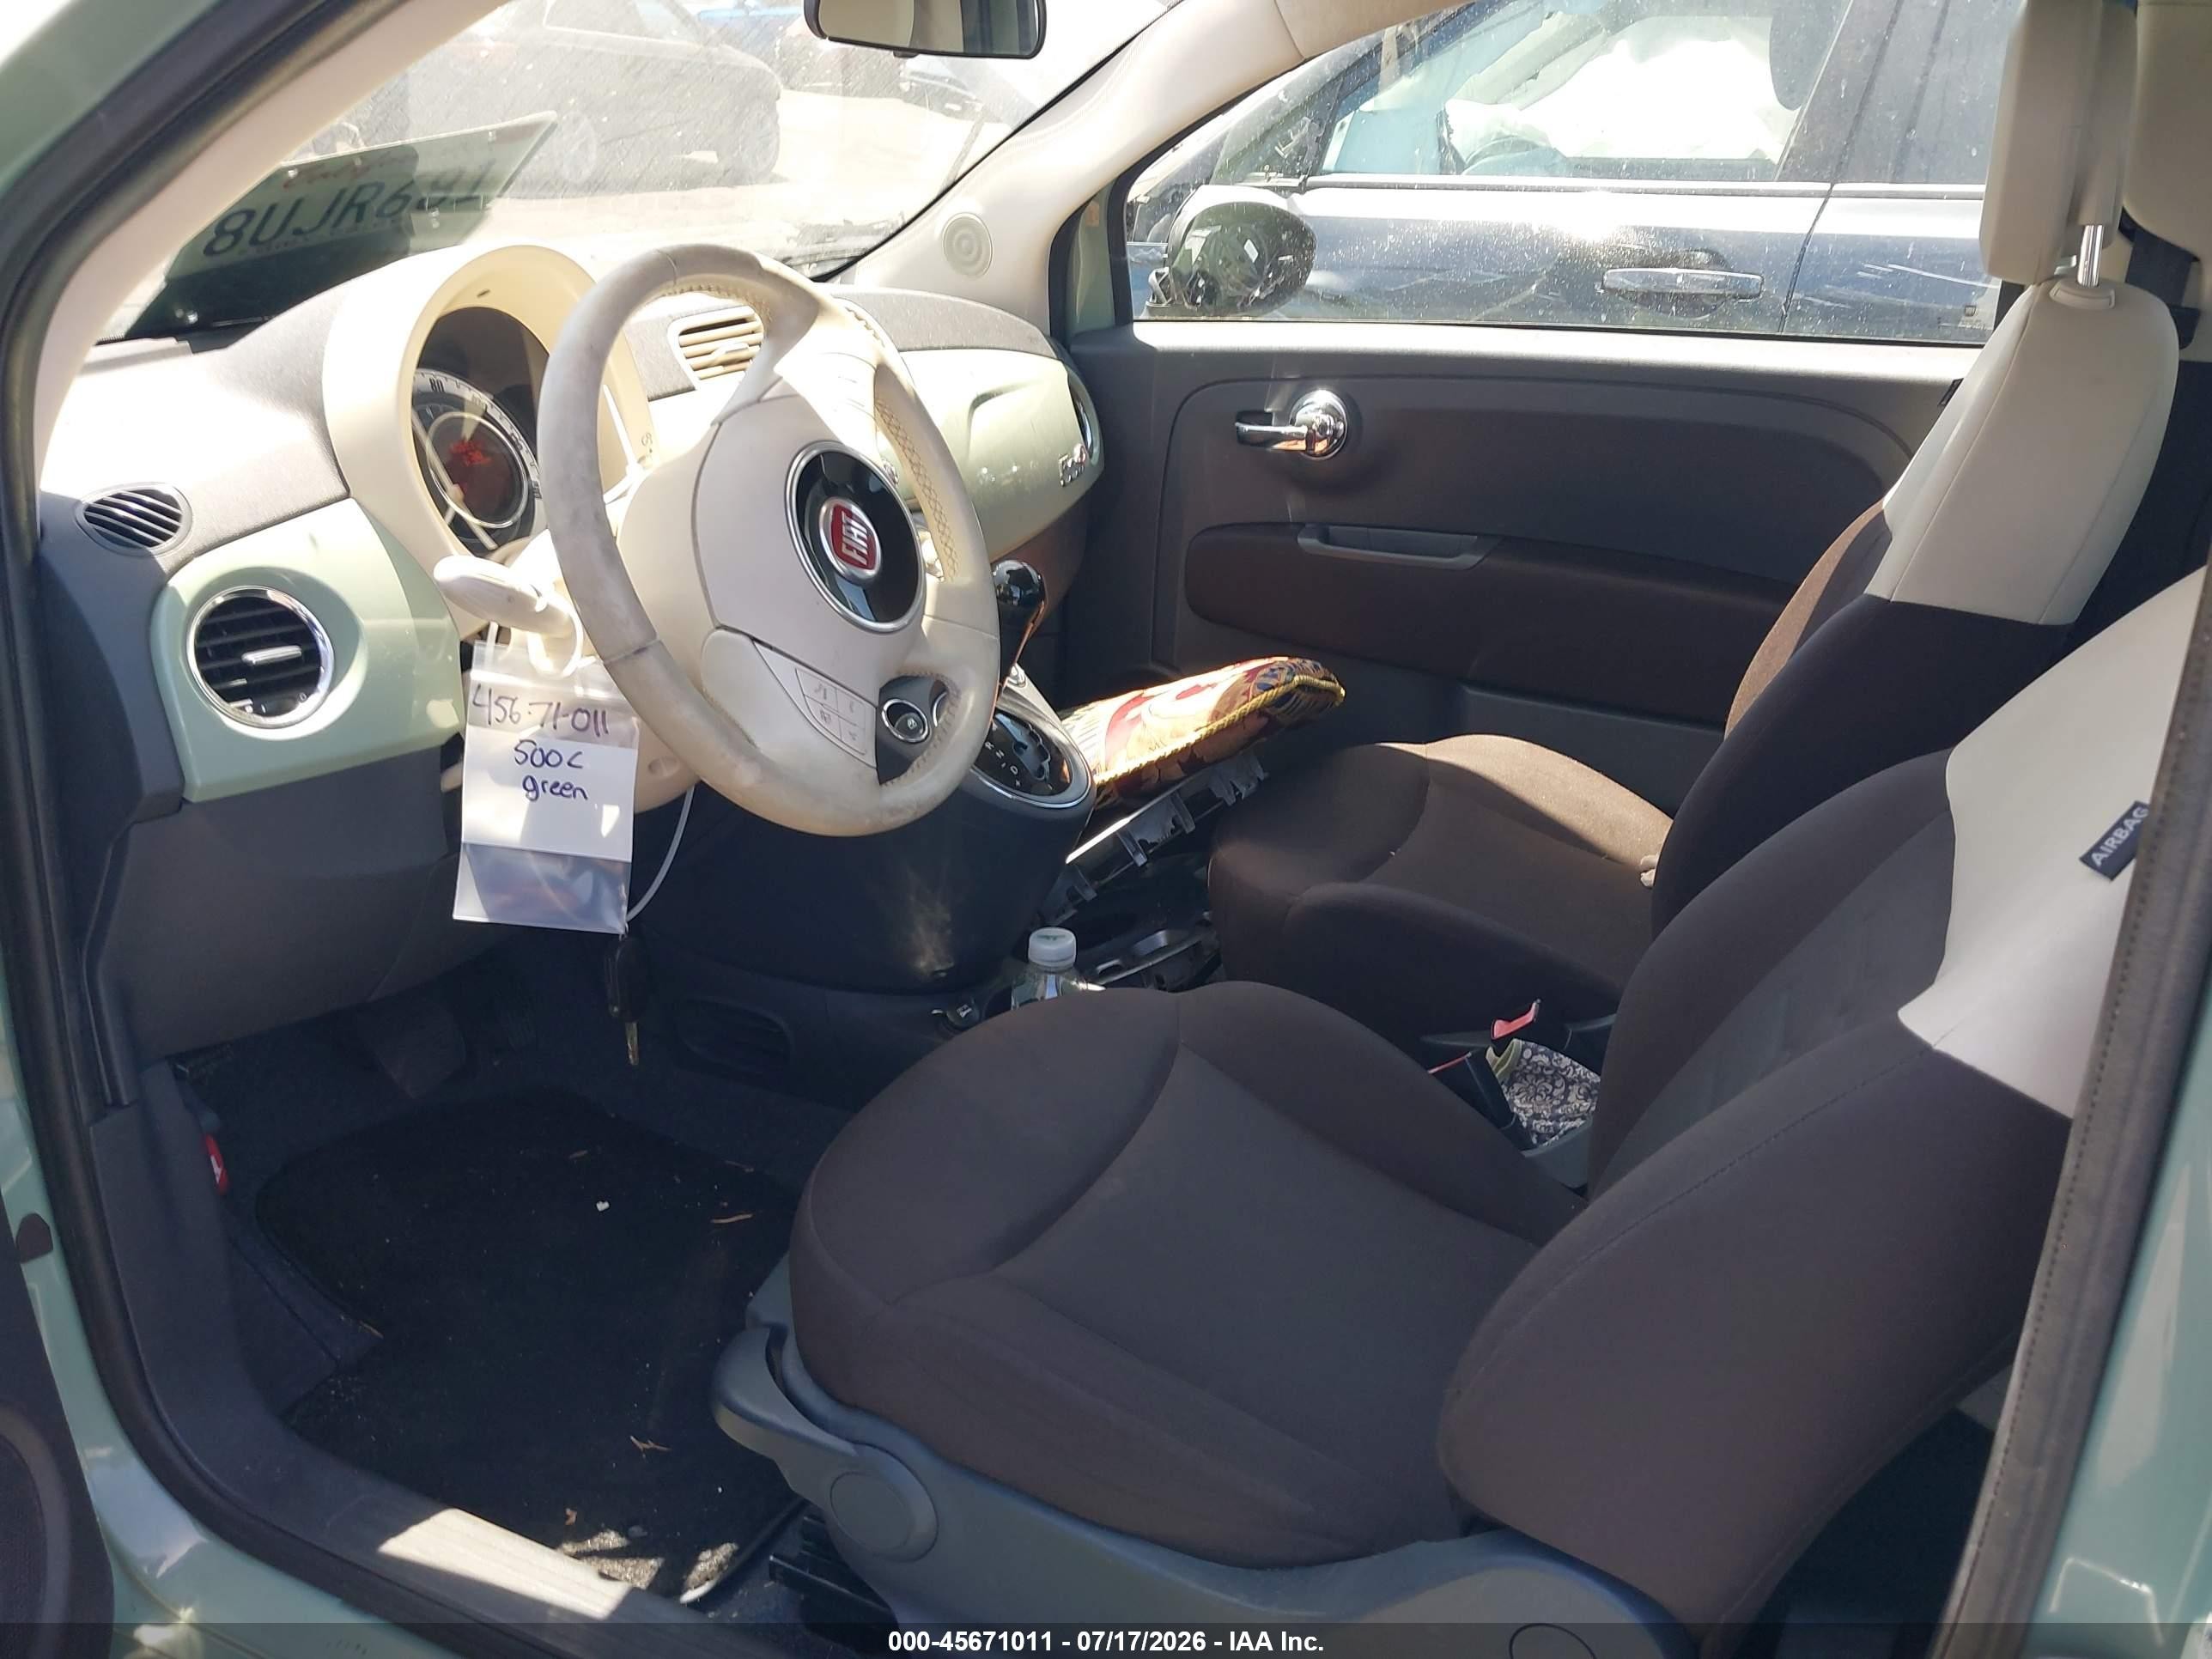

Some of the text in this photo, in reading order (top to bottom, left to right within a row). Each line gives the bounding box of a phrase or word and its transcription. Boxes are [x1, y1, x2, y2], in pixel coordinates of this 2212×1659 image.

[841, 510, 870, 566] FIAT
[522, 775, 588, 802] green
[2091, 806, 2149, 867] AIRBAG
